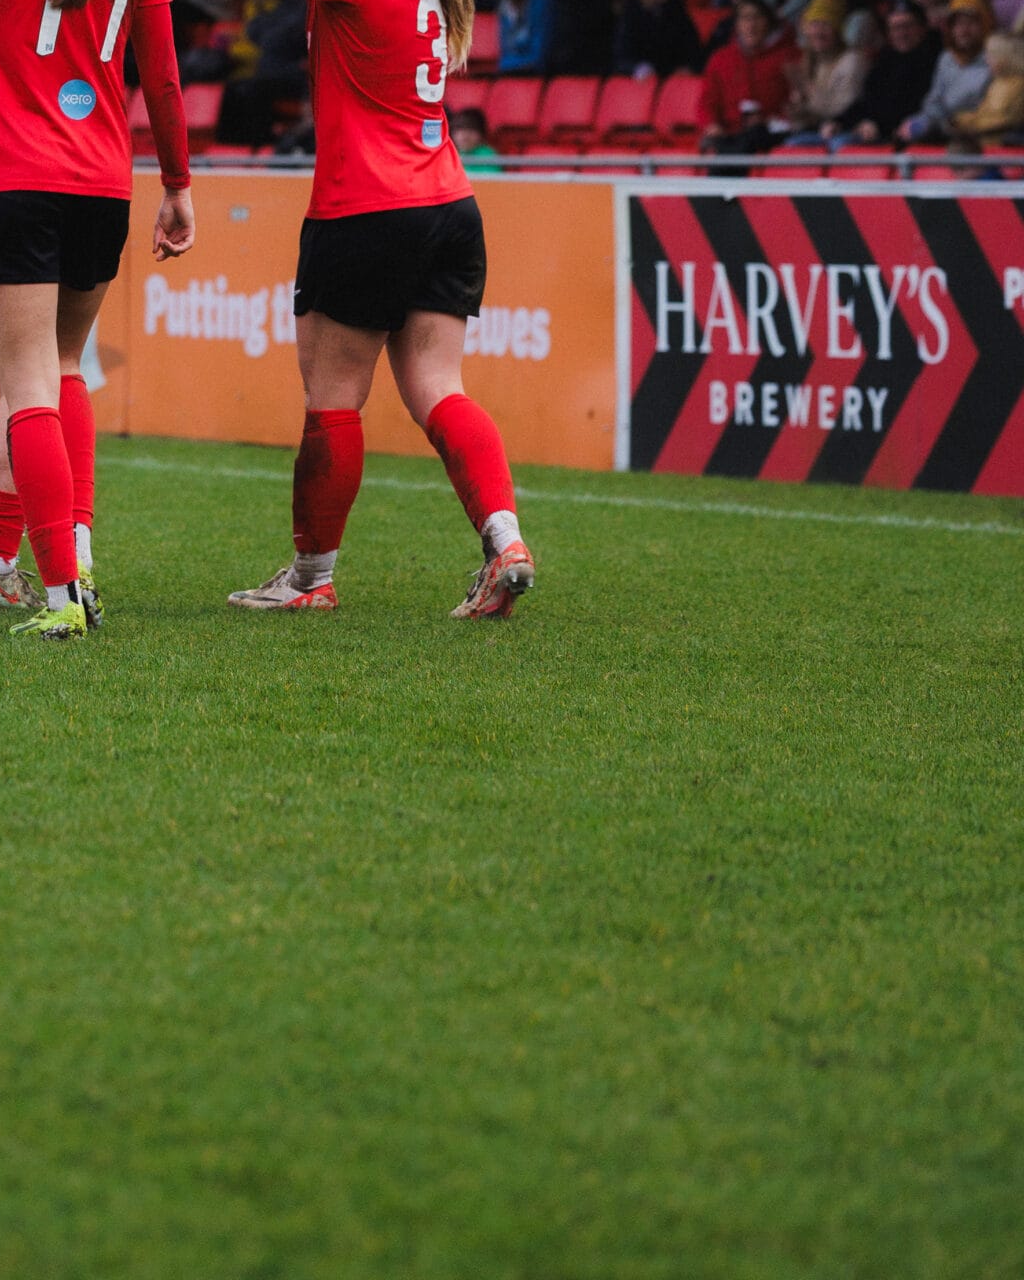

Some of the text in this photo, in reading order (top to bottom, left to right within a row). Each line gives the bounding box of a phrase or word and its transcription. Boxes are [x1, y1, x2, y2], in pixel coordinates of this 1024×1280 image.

[61, 93, 93, 105] xero
[654, 261, 950, 365] HARVEY'S
[1003, 266, 1024, 310] P
[143, 274, 269, 359] Putting
[708, 380, 890, 432] BREWERY
